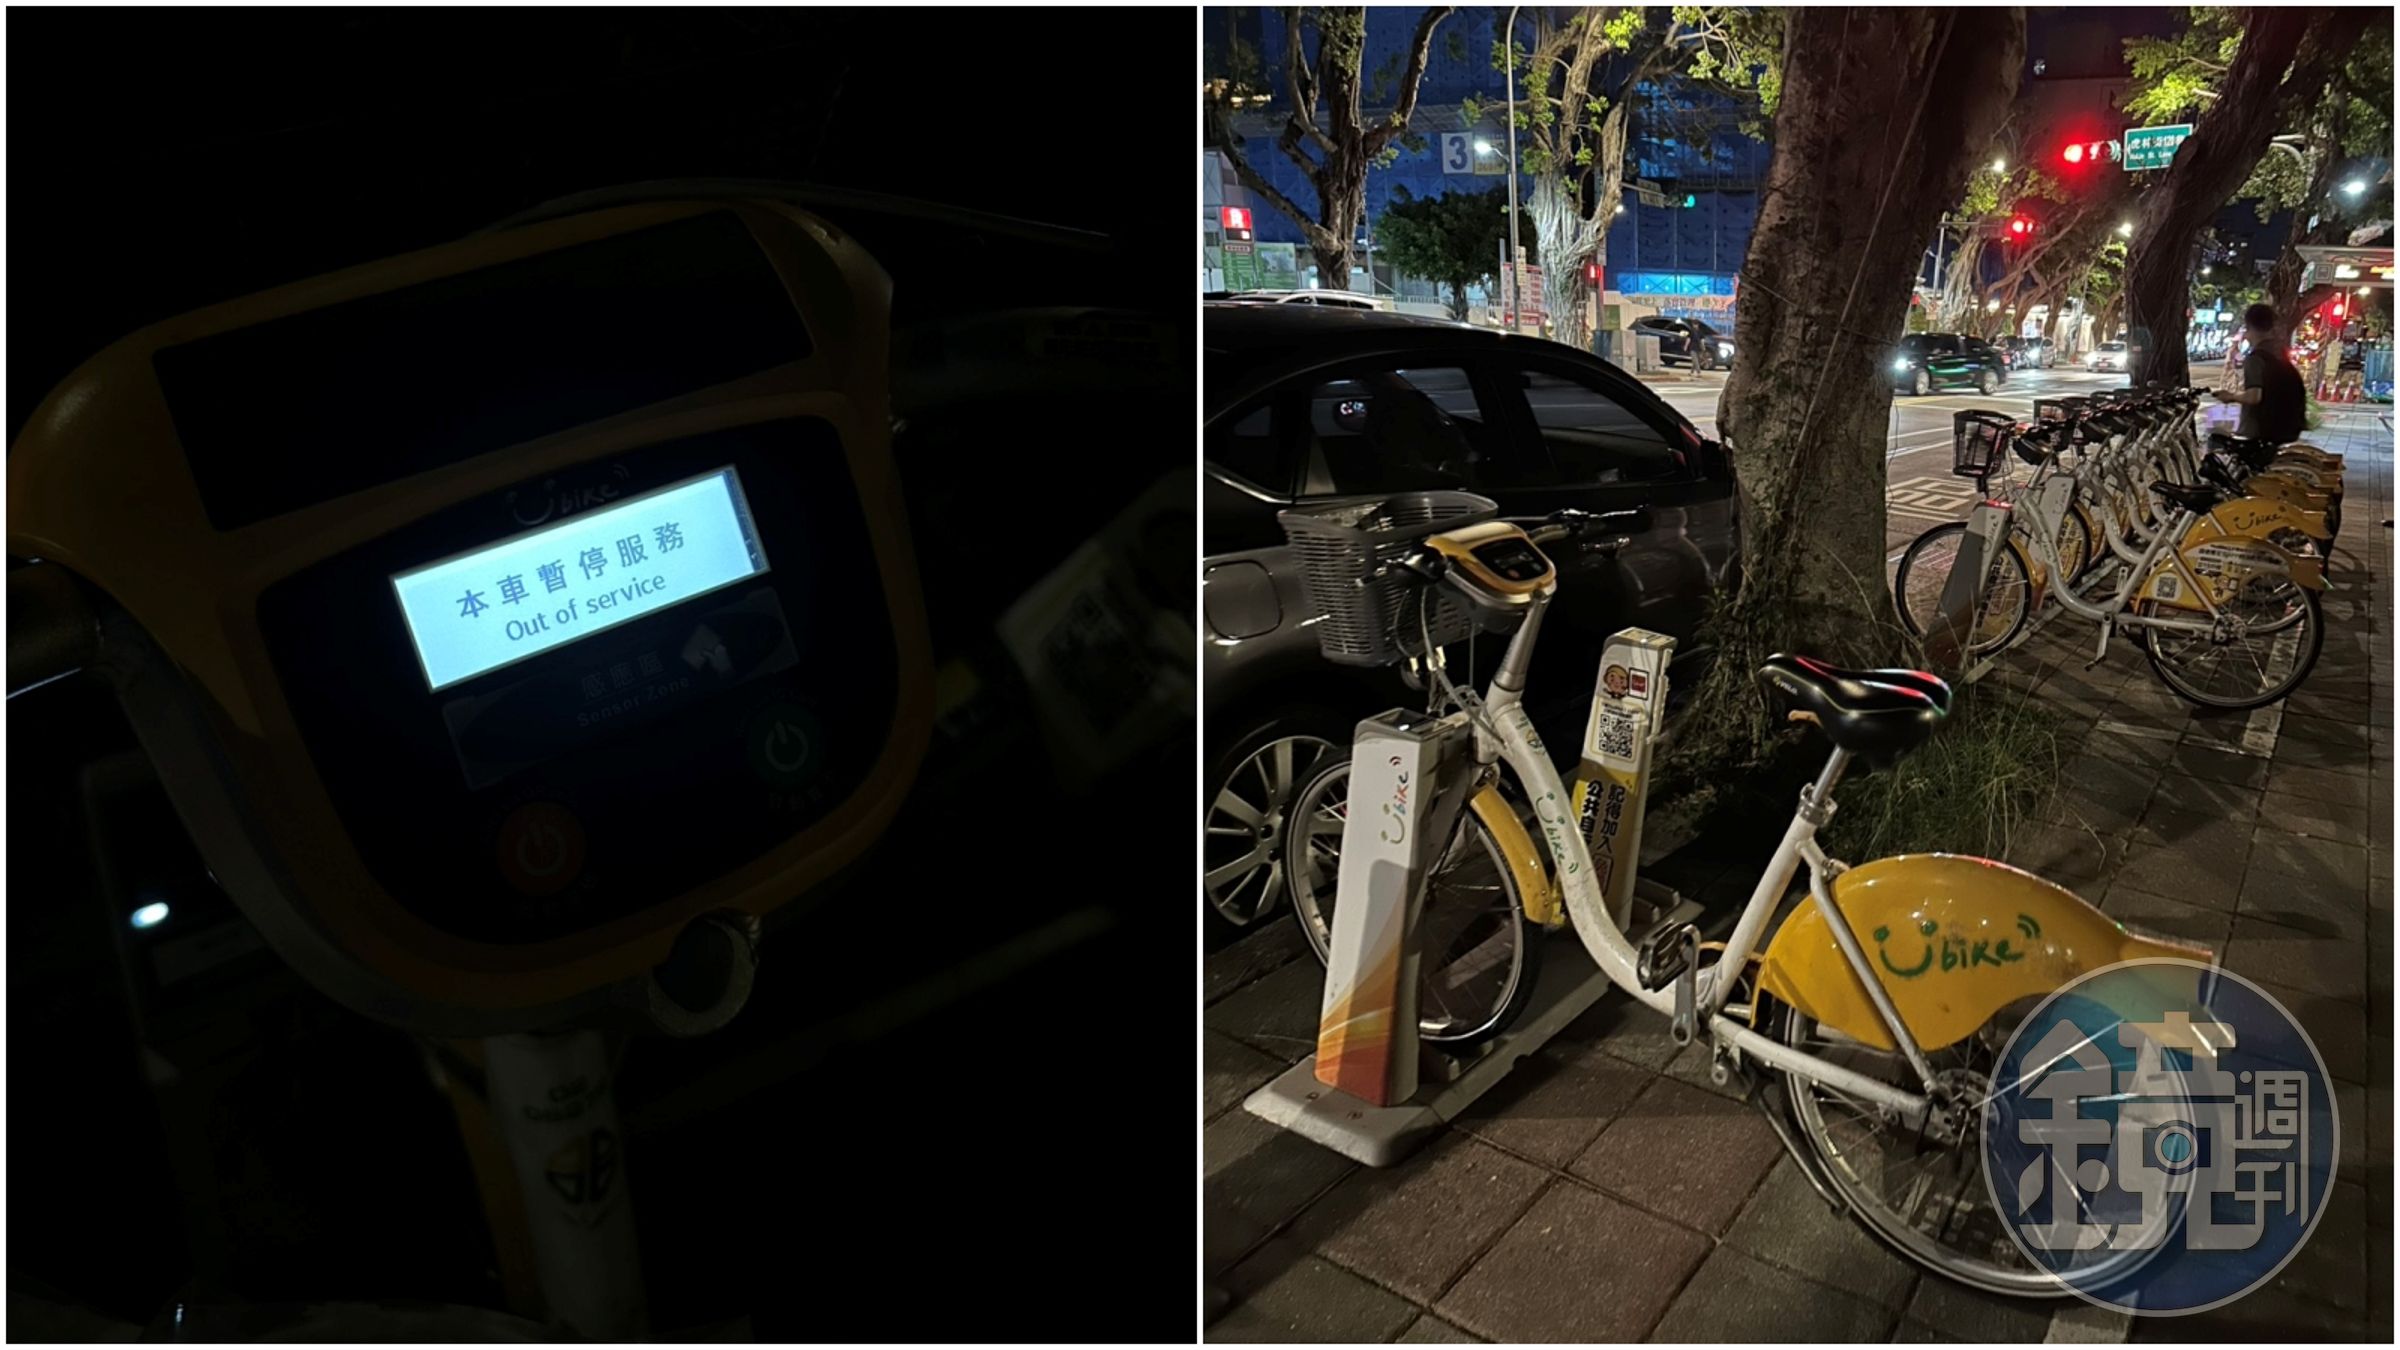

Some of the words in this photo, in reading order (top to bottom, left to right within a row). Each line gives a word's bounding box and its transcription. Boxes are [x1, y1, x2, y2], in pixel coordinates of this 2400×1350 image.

[1449, 135, 1468, 171] 3
[455, 520, 686, 621] 本車暫停服務
[505, 609, 551, 642] Out
[556, 602, 581, 626] of
[587, 571, 667, 615] service
[575, 693, 642, 728] Sensor
[647, 675, 690, 705] Zone
[581, 649, 665, 700] 感應區
[1596, 783, 1626, 855] 記得加入
